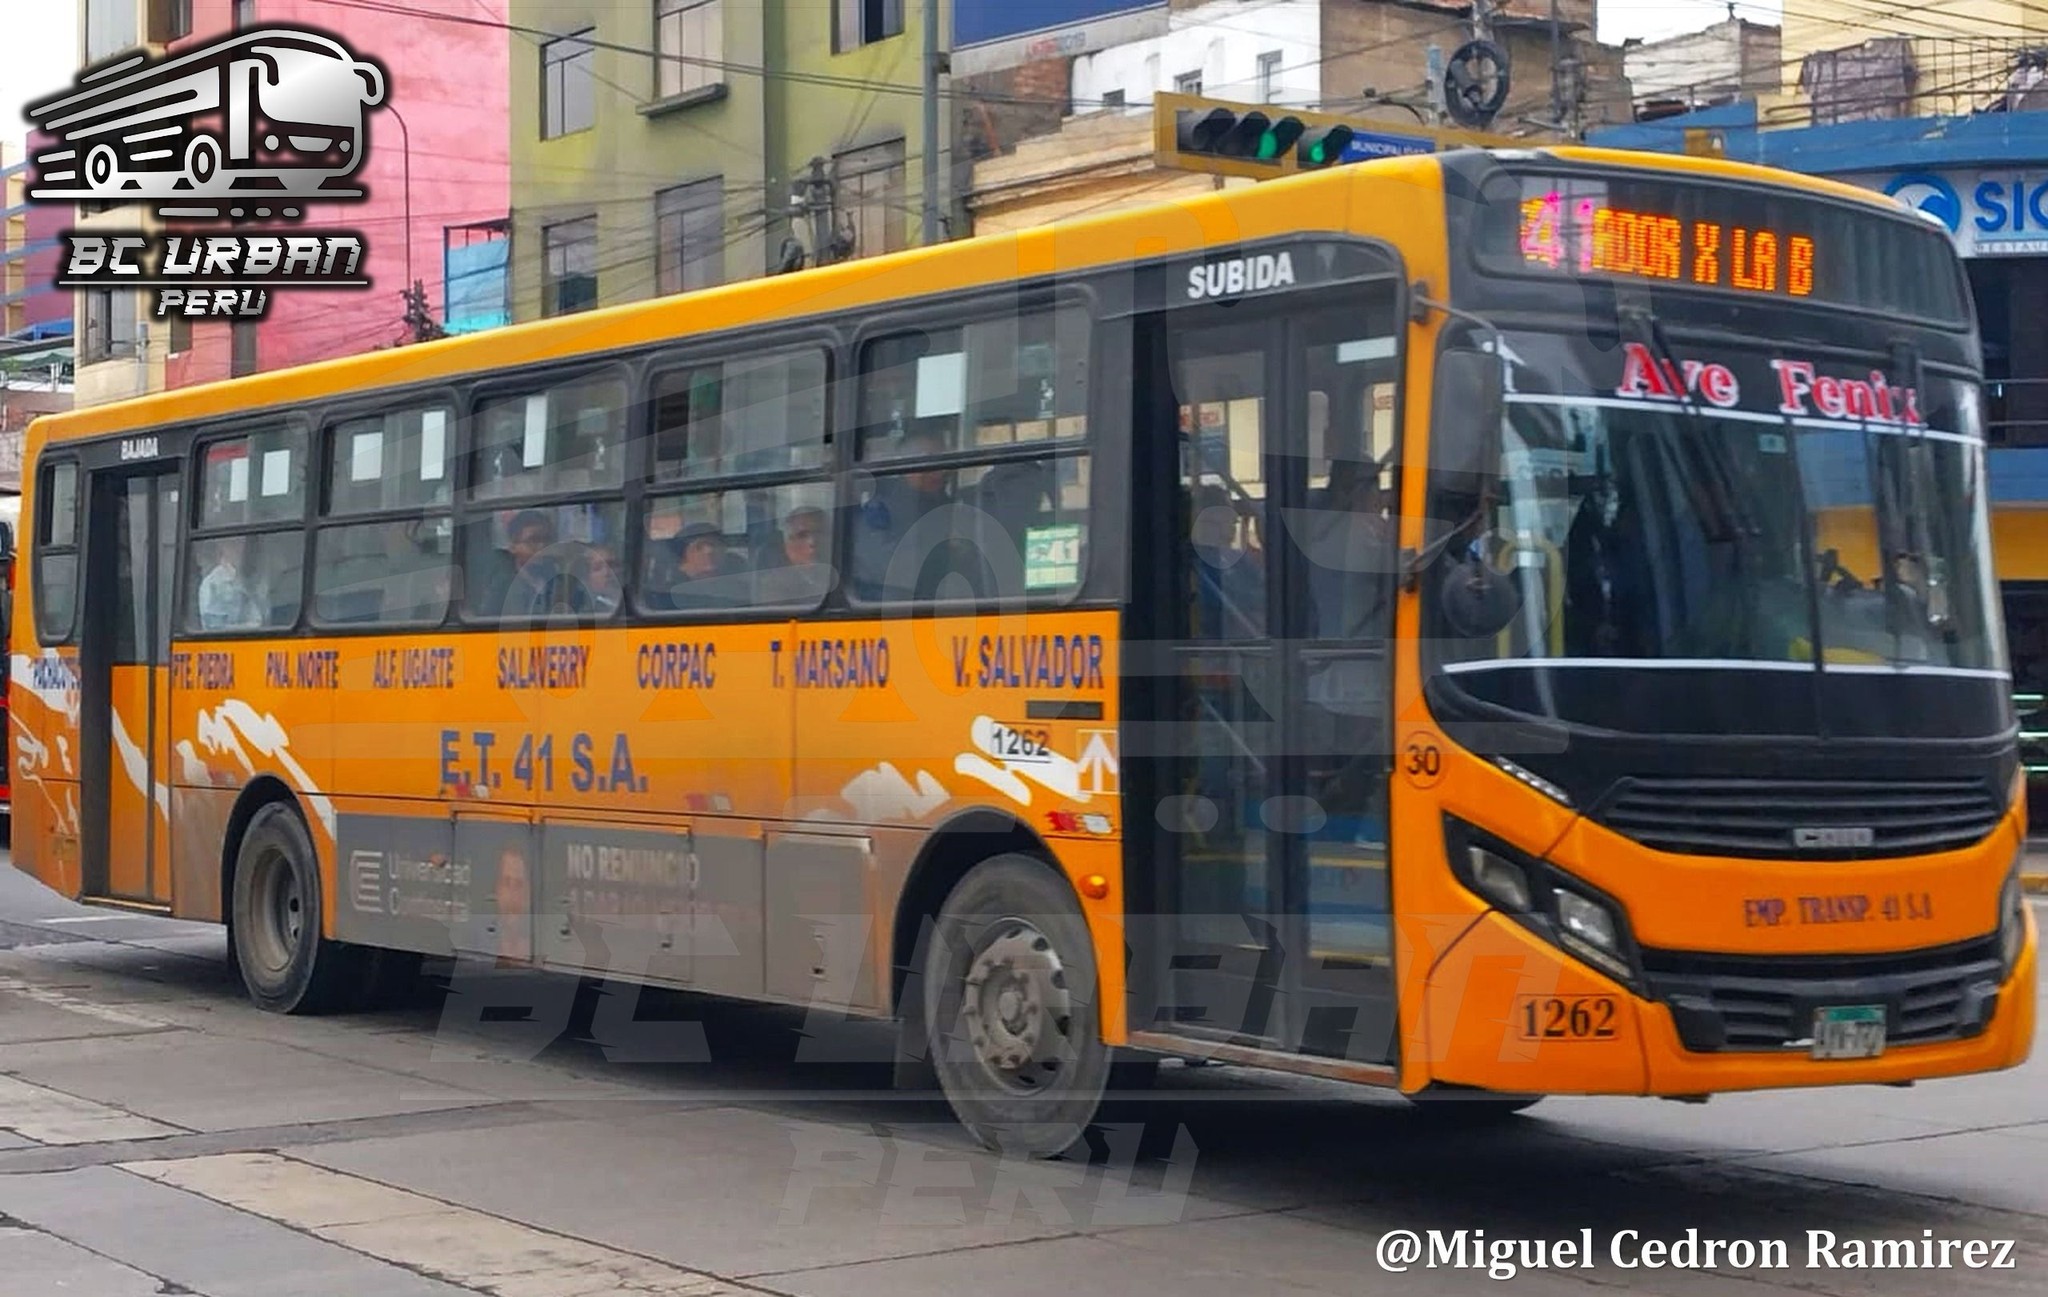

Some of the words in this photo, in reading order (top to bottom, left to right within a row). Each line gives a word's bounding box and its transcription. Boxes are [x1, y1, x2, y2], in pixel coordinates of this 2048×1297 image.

[1187, 252, 1296, 300] SUBIDA
[1693, 221, 1721, 284] X
[1731, 227, 1778, 292] LA
[1615, 342, 1740, 408] Ave
[297, 650, 339, 690] NORTE
[402, 647, 455, 689] UGARTE
[497, 645, 590, 690] SALAVERRY
[637, 642, 716, 689] CORPAC
[794, 637, 889, 688] MARSANO
[952, 635, 971, 687] V.
[978, 634, 1105, 689] SALVADOR
[440, 730, 500, 790] E.T.
[513, 733, 554, 791] 41
[571, 732, 648, 793] S.A.
[991, 727, 1051, 758] 1262
[1406, 745, 1440, 777] 30
[1522, 998, 1617, 1037] 1262
